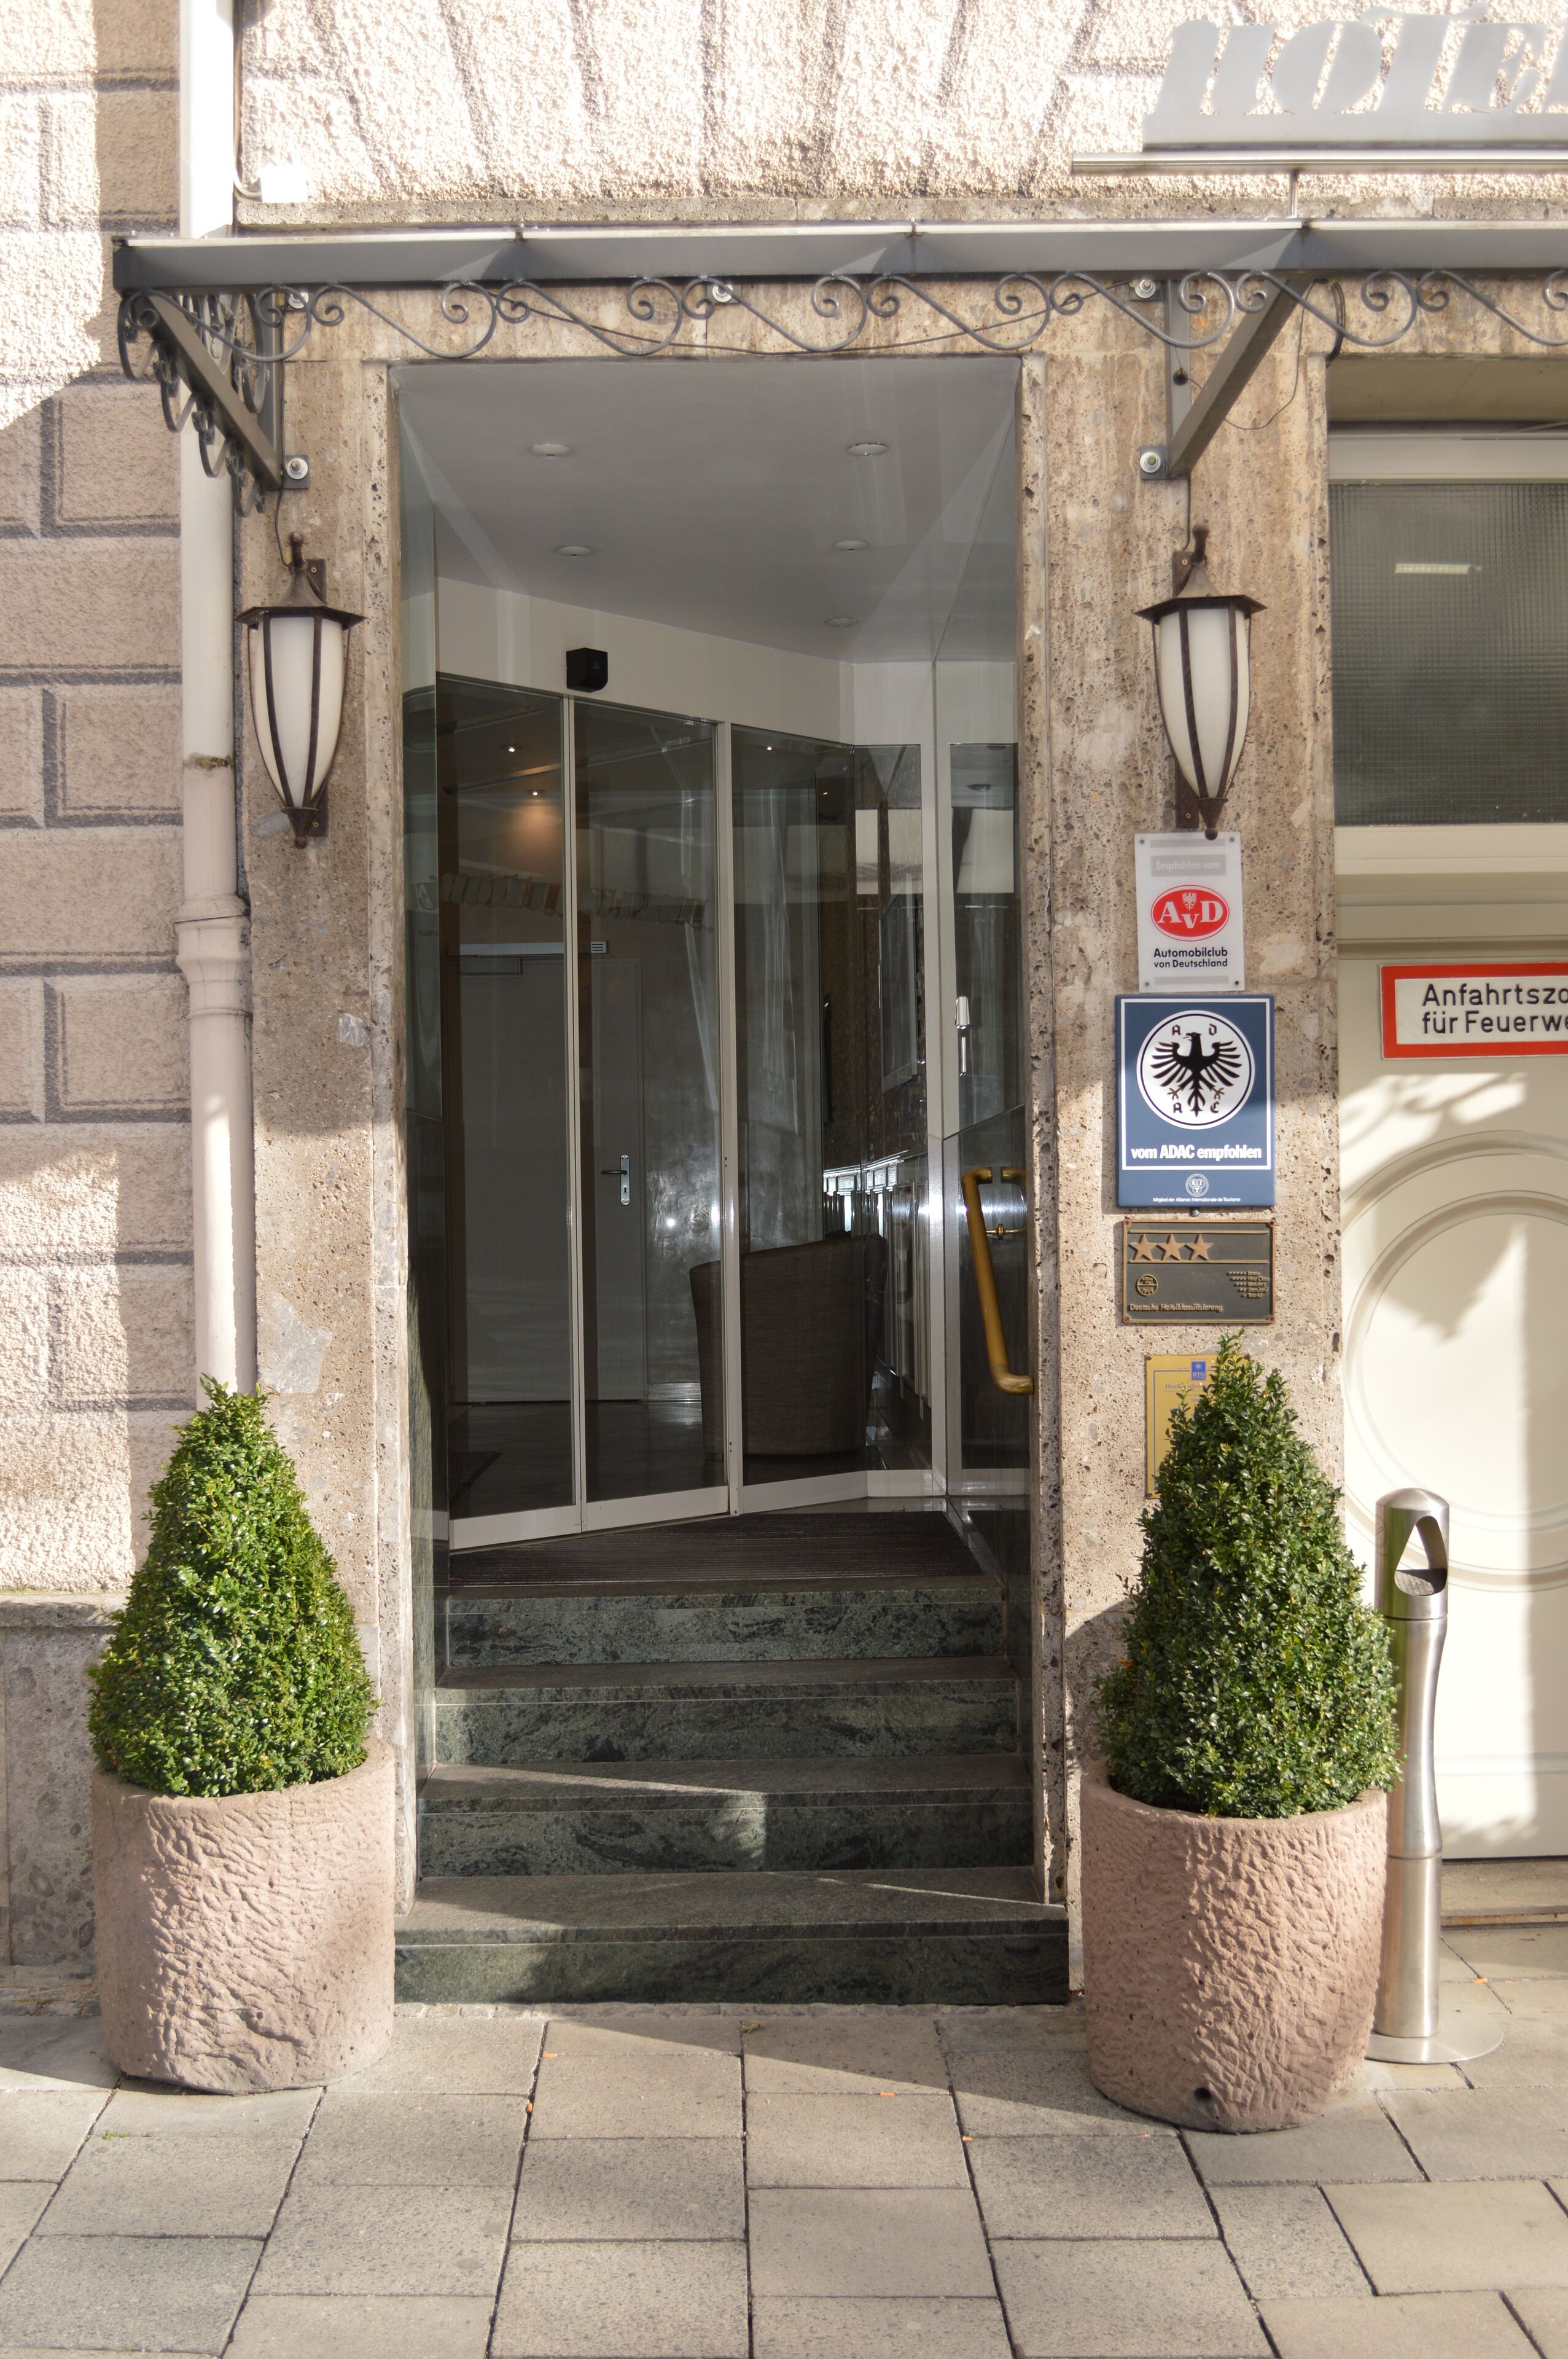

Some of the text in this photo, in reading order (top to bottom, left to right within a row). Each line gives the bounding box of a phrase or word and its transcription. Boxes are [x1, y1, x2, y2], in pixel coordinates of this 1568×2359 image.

[1155, 861, 1201, 872] Empfohlen
[1153, 947, 1228, 958] Automobilclub
[1172, 958, 1228, 968] Deutschland
[1422, 1010, 1568, 1034] für Feuerw
[1131, 1144, 1262, 1162] vom ADAC empfohlen
